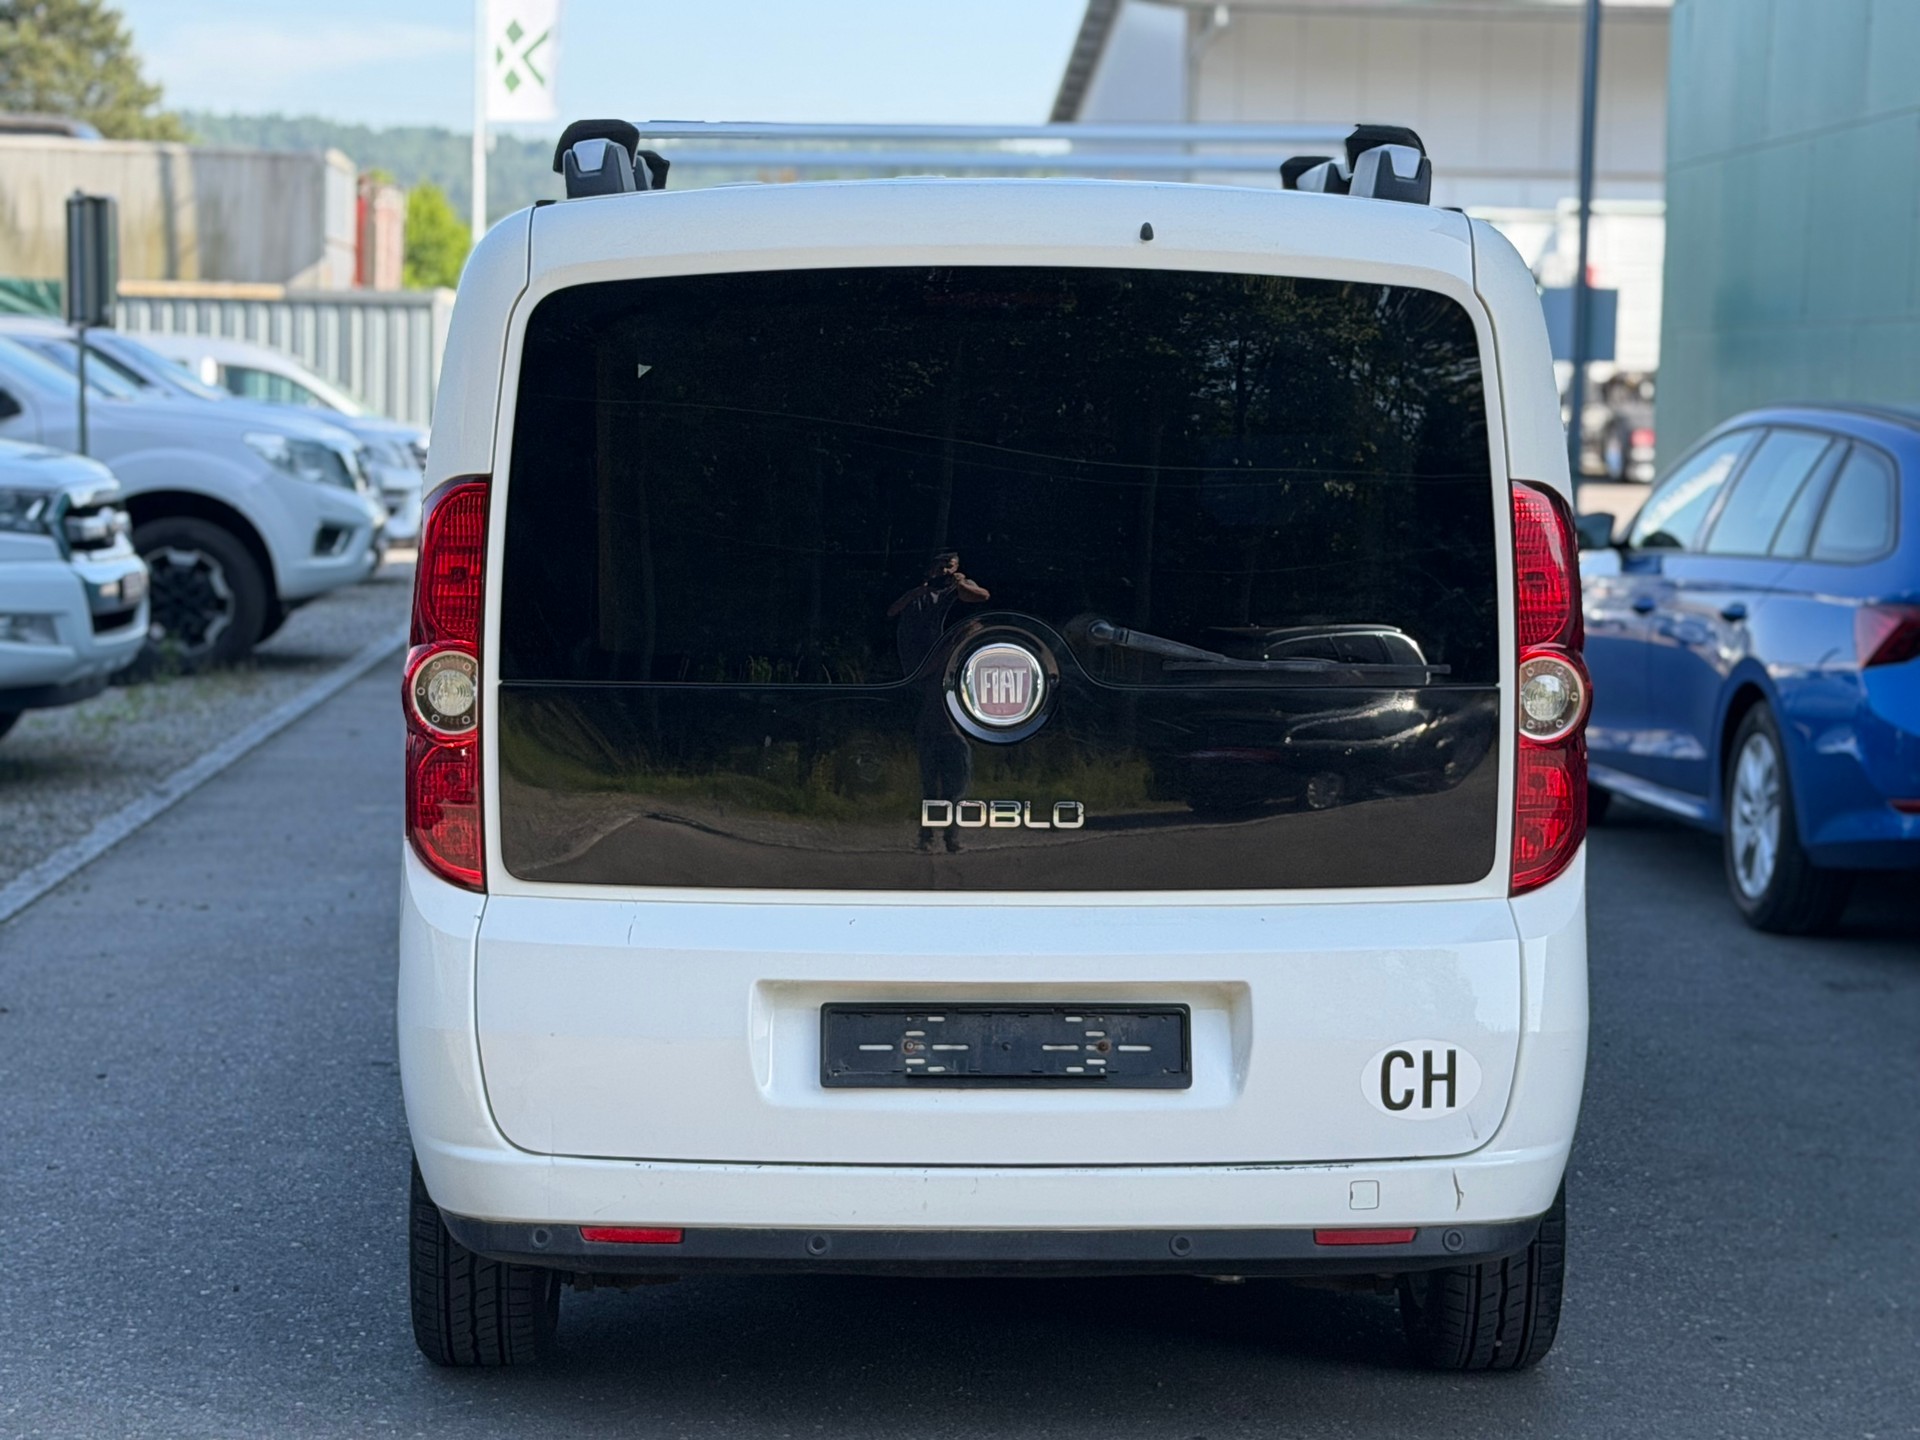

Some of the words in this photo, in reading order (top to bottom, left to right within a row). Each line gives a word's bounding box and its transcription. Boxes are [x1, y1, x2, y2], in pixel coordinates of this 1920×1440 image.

[980, 667, 1027, 704] FIAT
[921, 799, 1085, 829] DOBLO
[1380, 1049, 1457, 1112] CH
